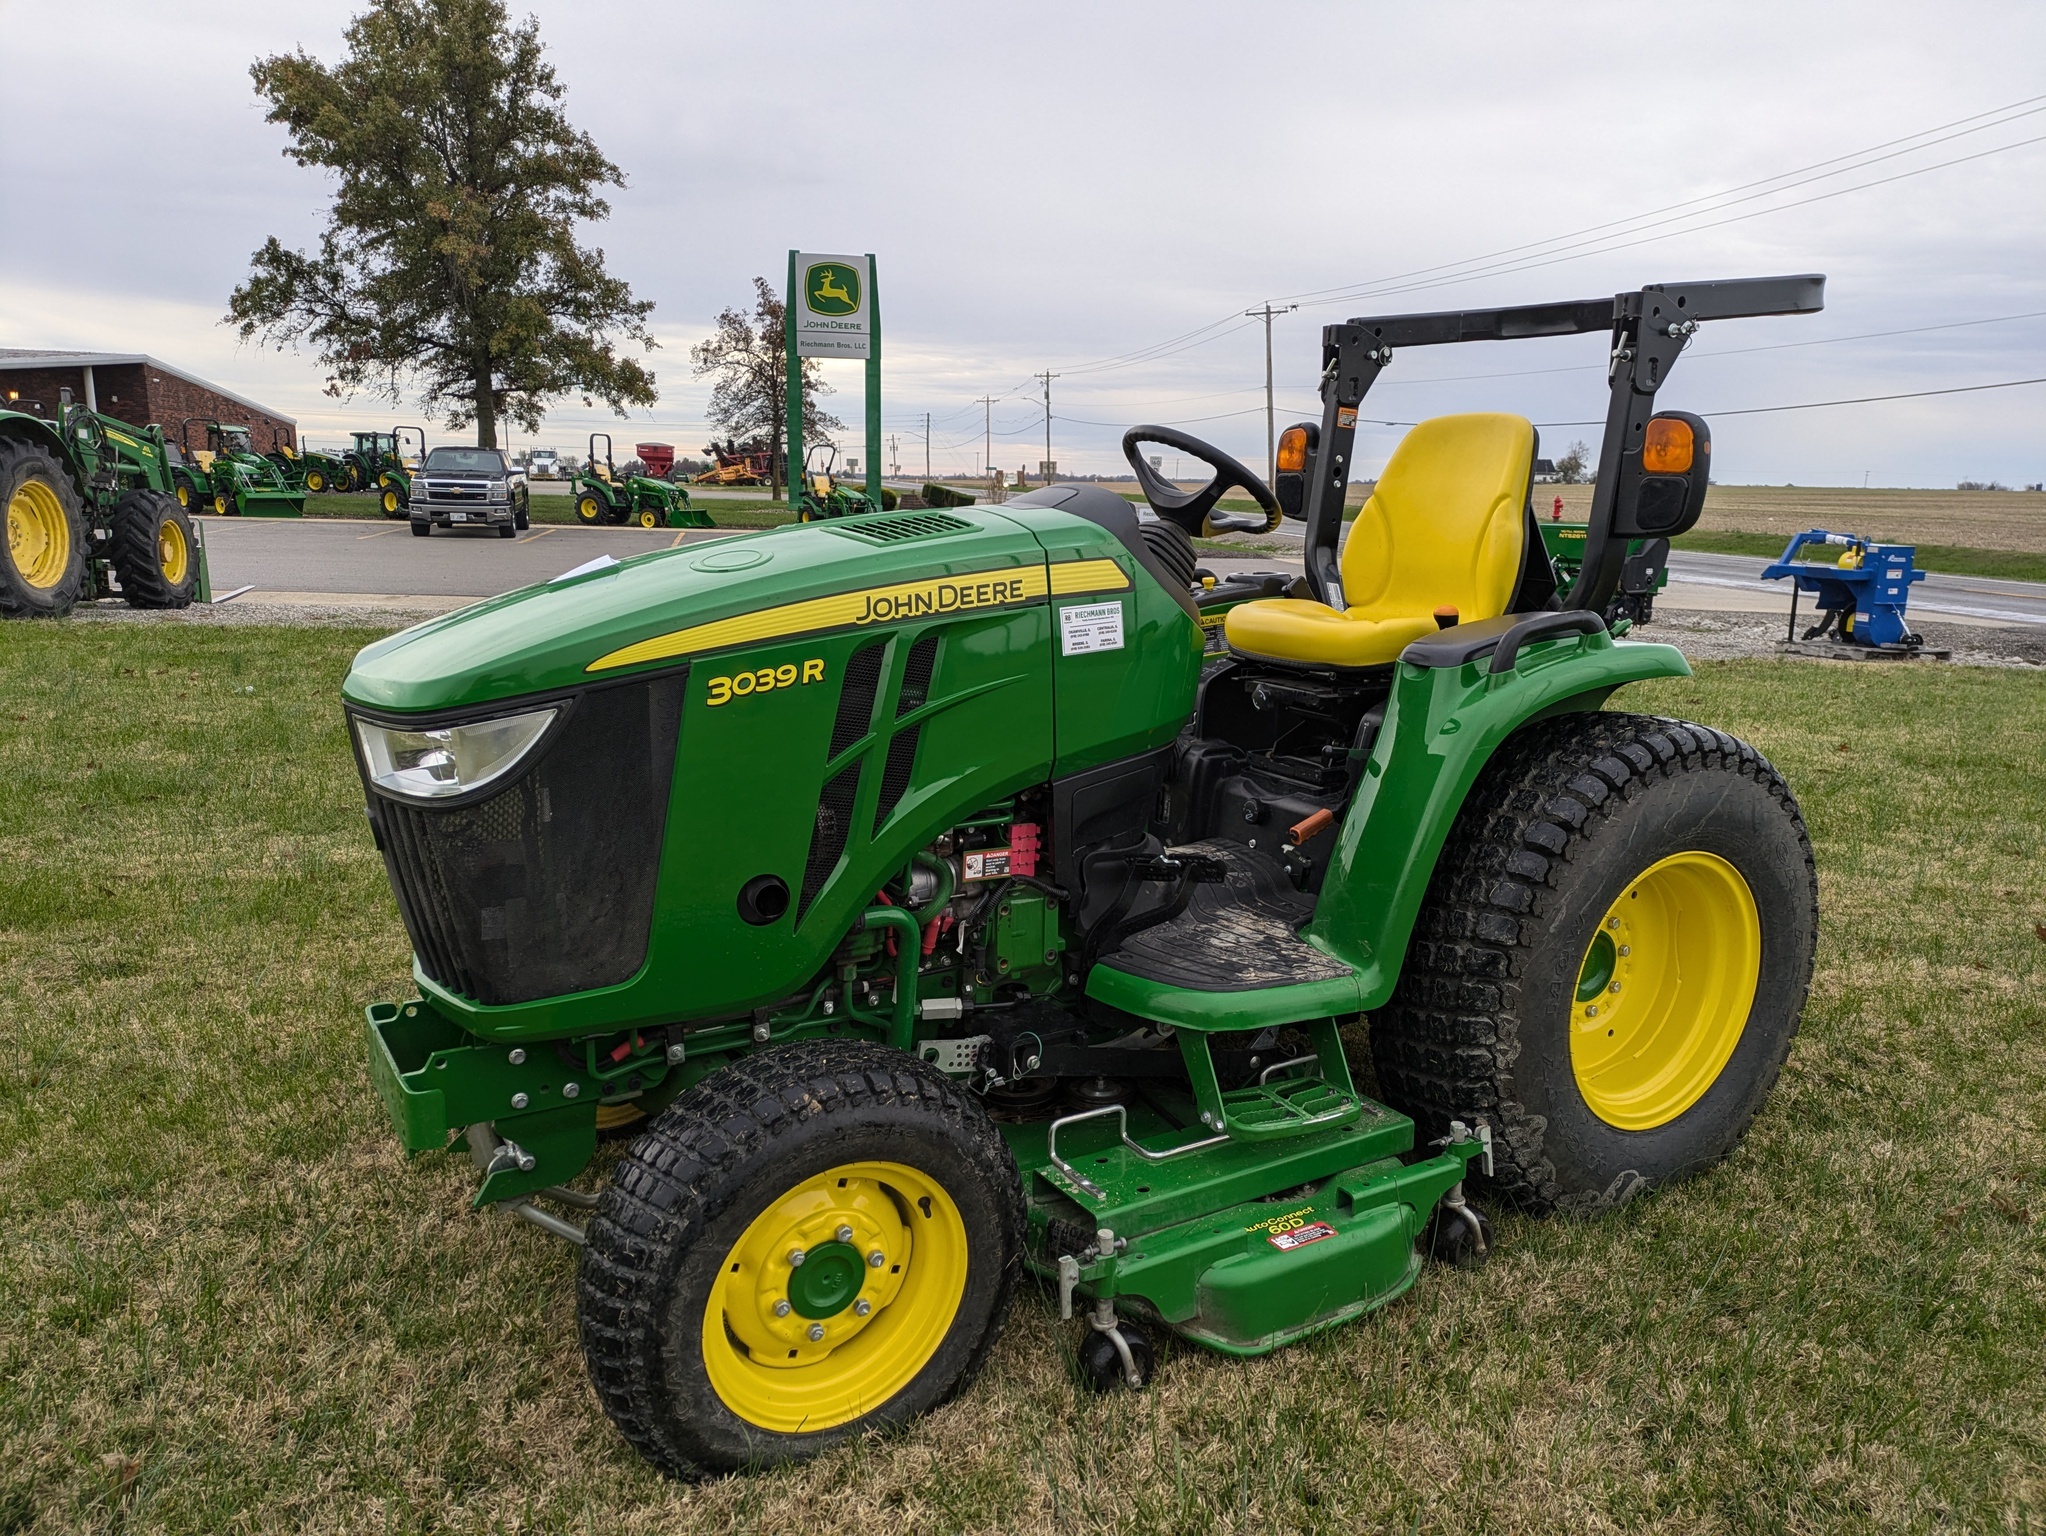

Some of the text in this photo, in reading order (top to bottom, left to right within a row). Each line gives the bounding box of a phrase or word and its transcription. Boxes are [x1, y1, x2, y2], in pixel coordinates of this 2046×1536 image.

[803, 319, 862, 331] JOHN DEERE
[800, 340, 867, 350] Riechmann Bros. LLC
[855, 578, 1025, 625] JOHN DEERE
[1074, 609, 1106, 619] RIECHMANN
[1106, 607, 1121, 615] BROS
[1205, 616, 1226, 625] CAUTIO
[705, 658, 826, 707] 3039 R
[1268, 1218, 1305, 1235] 60D
